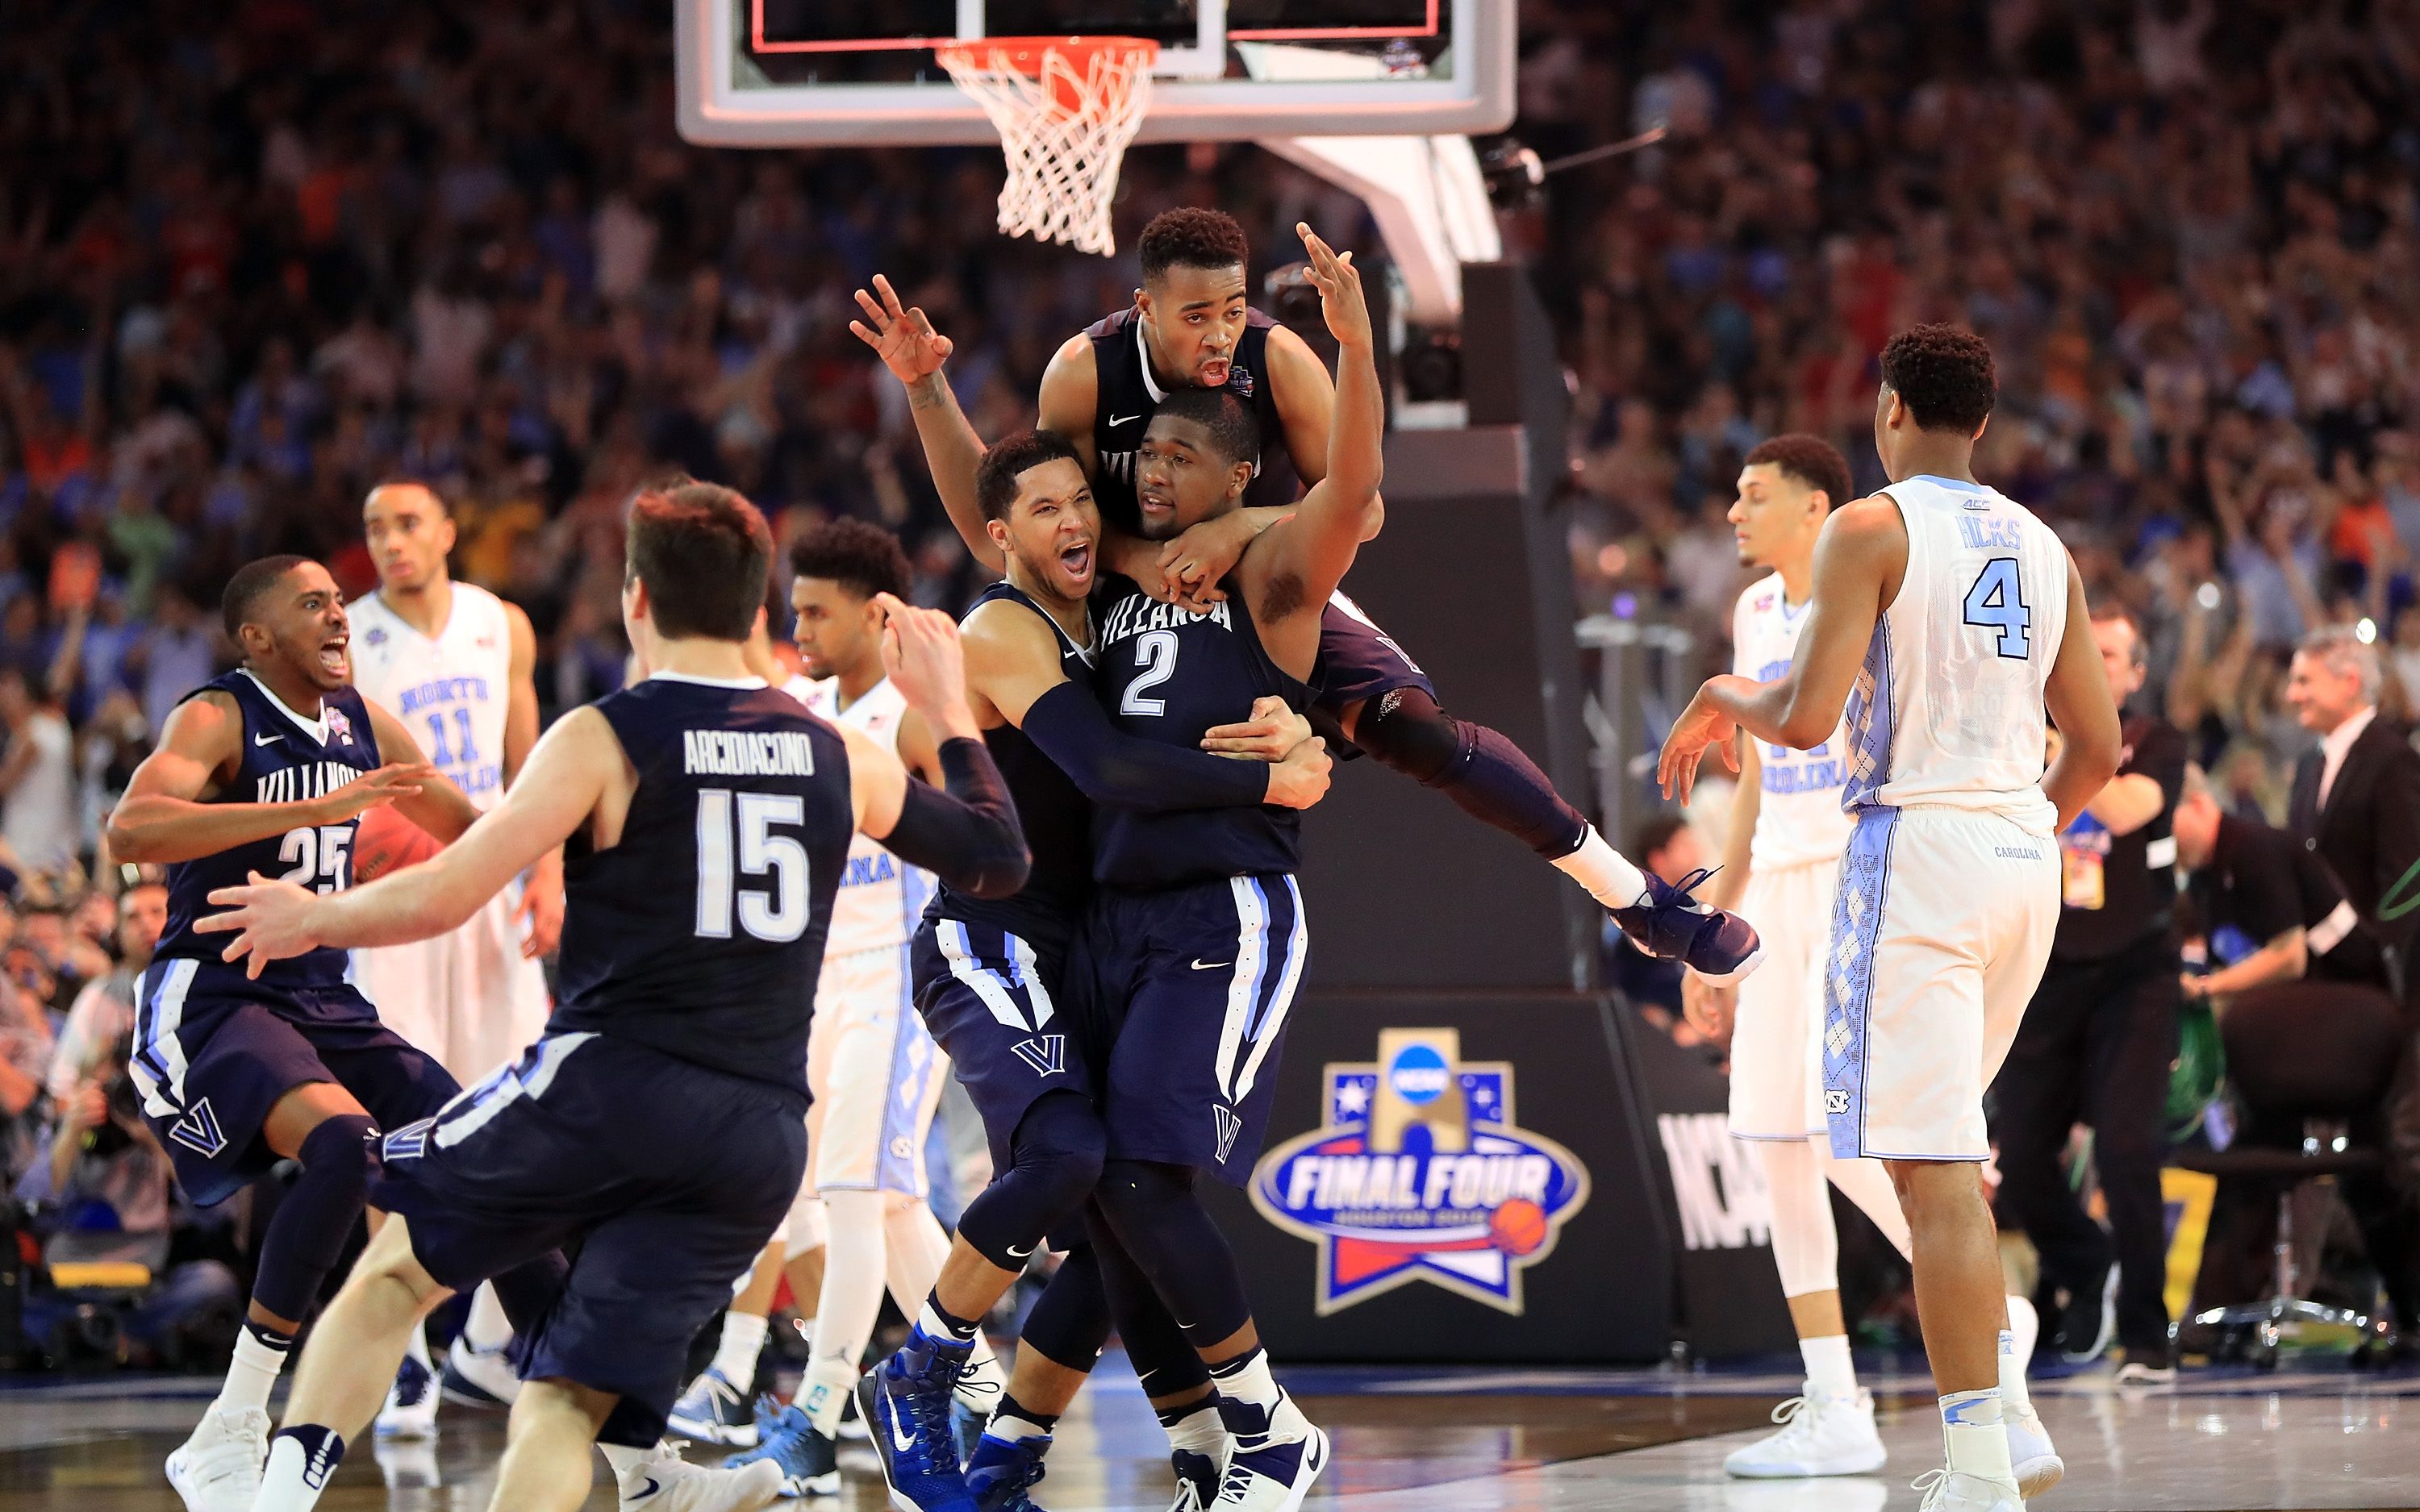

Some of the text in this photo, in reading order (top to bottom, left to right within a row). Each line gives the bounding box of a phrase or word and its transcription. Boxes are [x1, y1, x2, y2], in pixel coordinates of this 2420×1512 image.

[1963, 557, 2031, 660] 4
[1120, 629, 1179, 717] 2
[428, 708, 478, 767] 11
[683, 730, 815, 777] ARCIDIACONO
[277, 826, 354, 897] 25
[695, 787, 811, 943] 15
[1994, 847, 2042, 860] CAROLINA
[1287, 1154, 1554, 1210] FINAL FOUR
